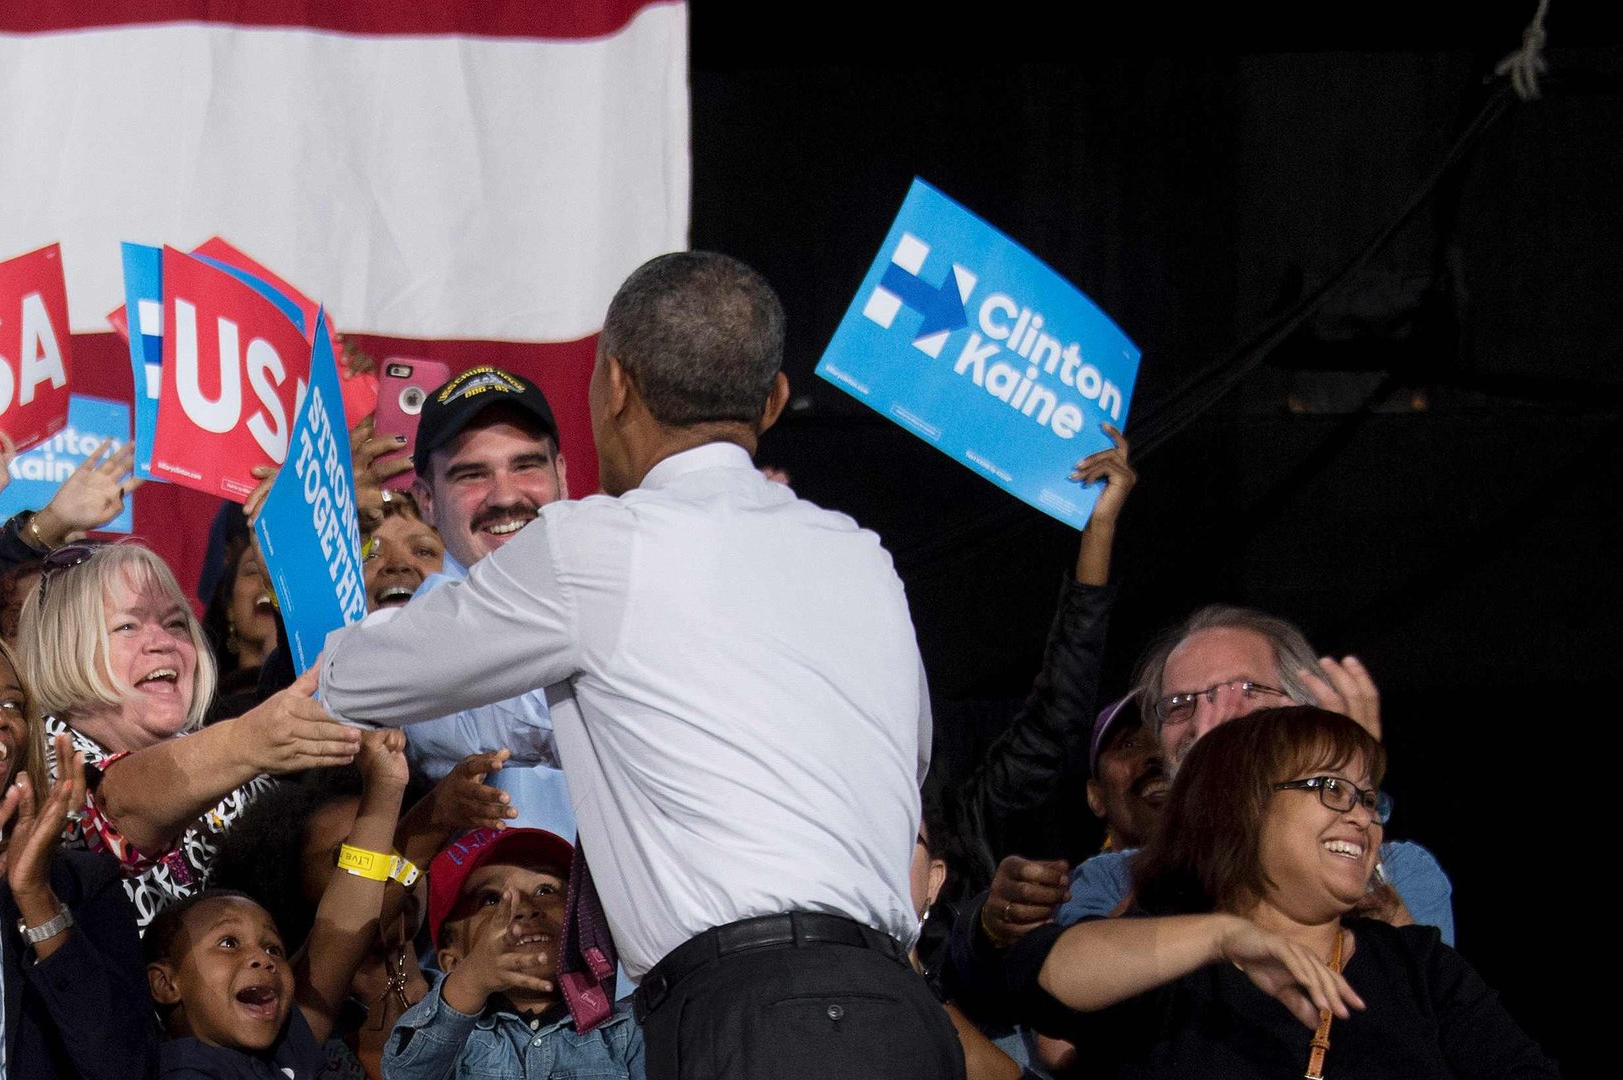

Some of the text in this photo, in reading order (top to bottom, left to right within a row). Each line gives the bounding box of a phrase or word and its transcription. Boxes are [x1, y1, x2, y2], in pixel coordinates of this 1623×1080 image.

[175, 297, 308, 466] US
[953, 333, 1083, 439] Kaine
[978, 295, 1124, 421] Clinton
[308, 386, 363, 568] STRONG
